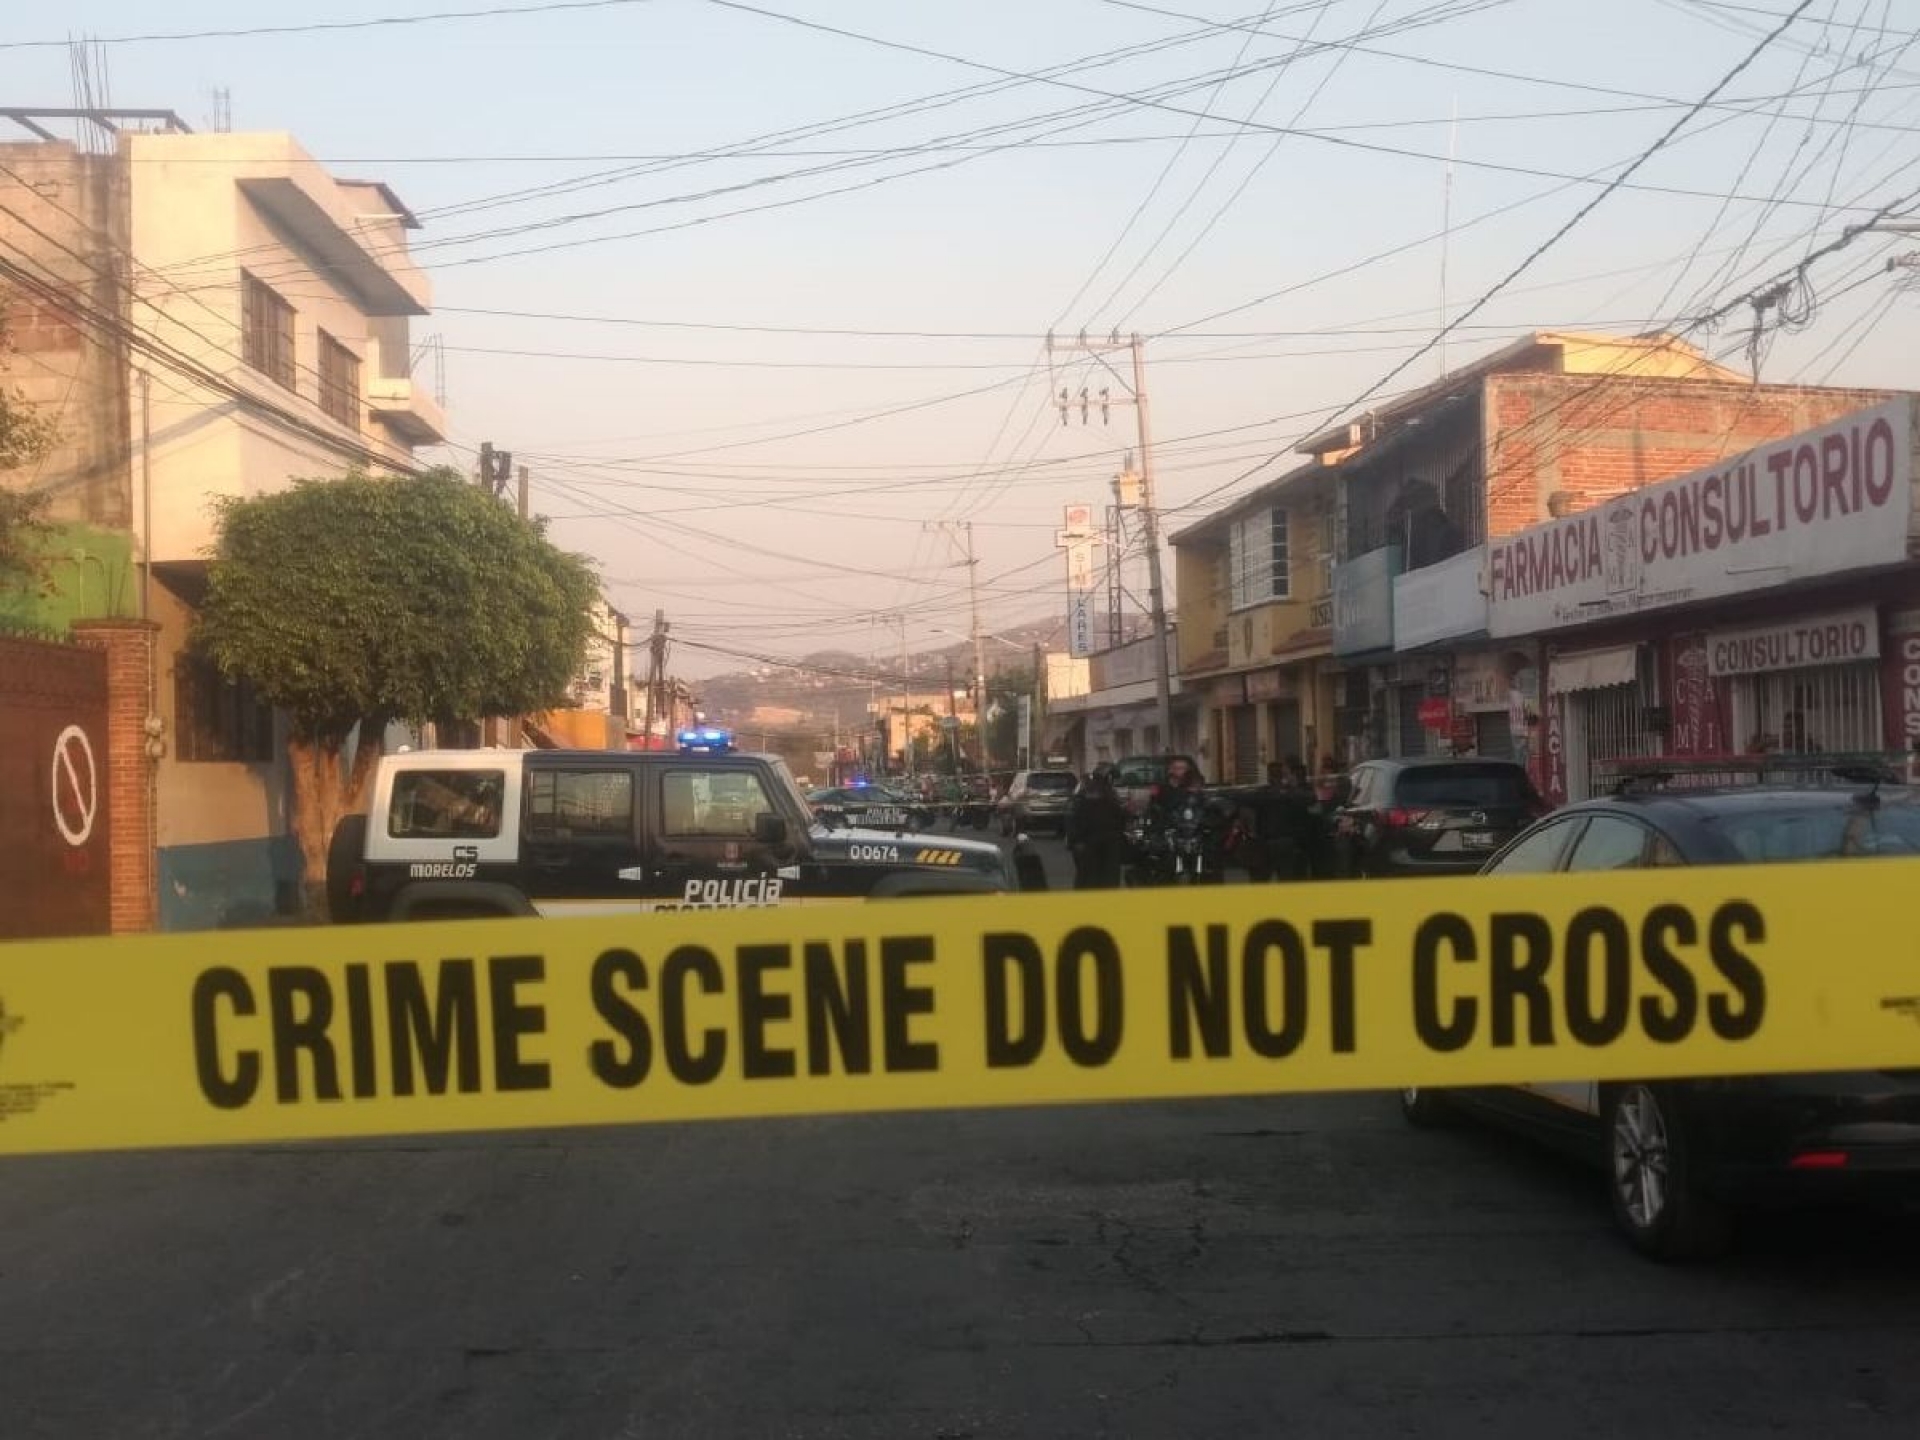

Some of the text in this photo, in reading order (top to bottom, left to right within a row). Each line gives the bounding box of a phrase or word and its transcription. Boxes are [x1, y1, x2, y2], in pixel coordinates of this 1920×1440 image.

[1490, 516, 1602, 601] FARMACIA
[1641, 417, 1895, 564] CONSULTORIO
[1714, 622, 1866, 672] CONSULTORIO
[410, 863, 478, 878] MORELOS
[850, 844, 899, 862] 00674
[192, 901, 1767, 1109] CRIME SCENE DO NOT CROSS
